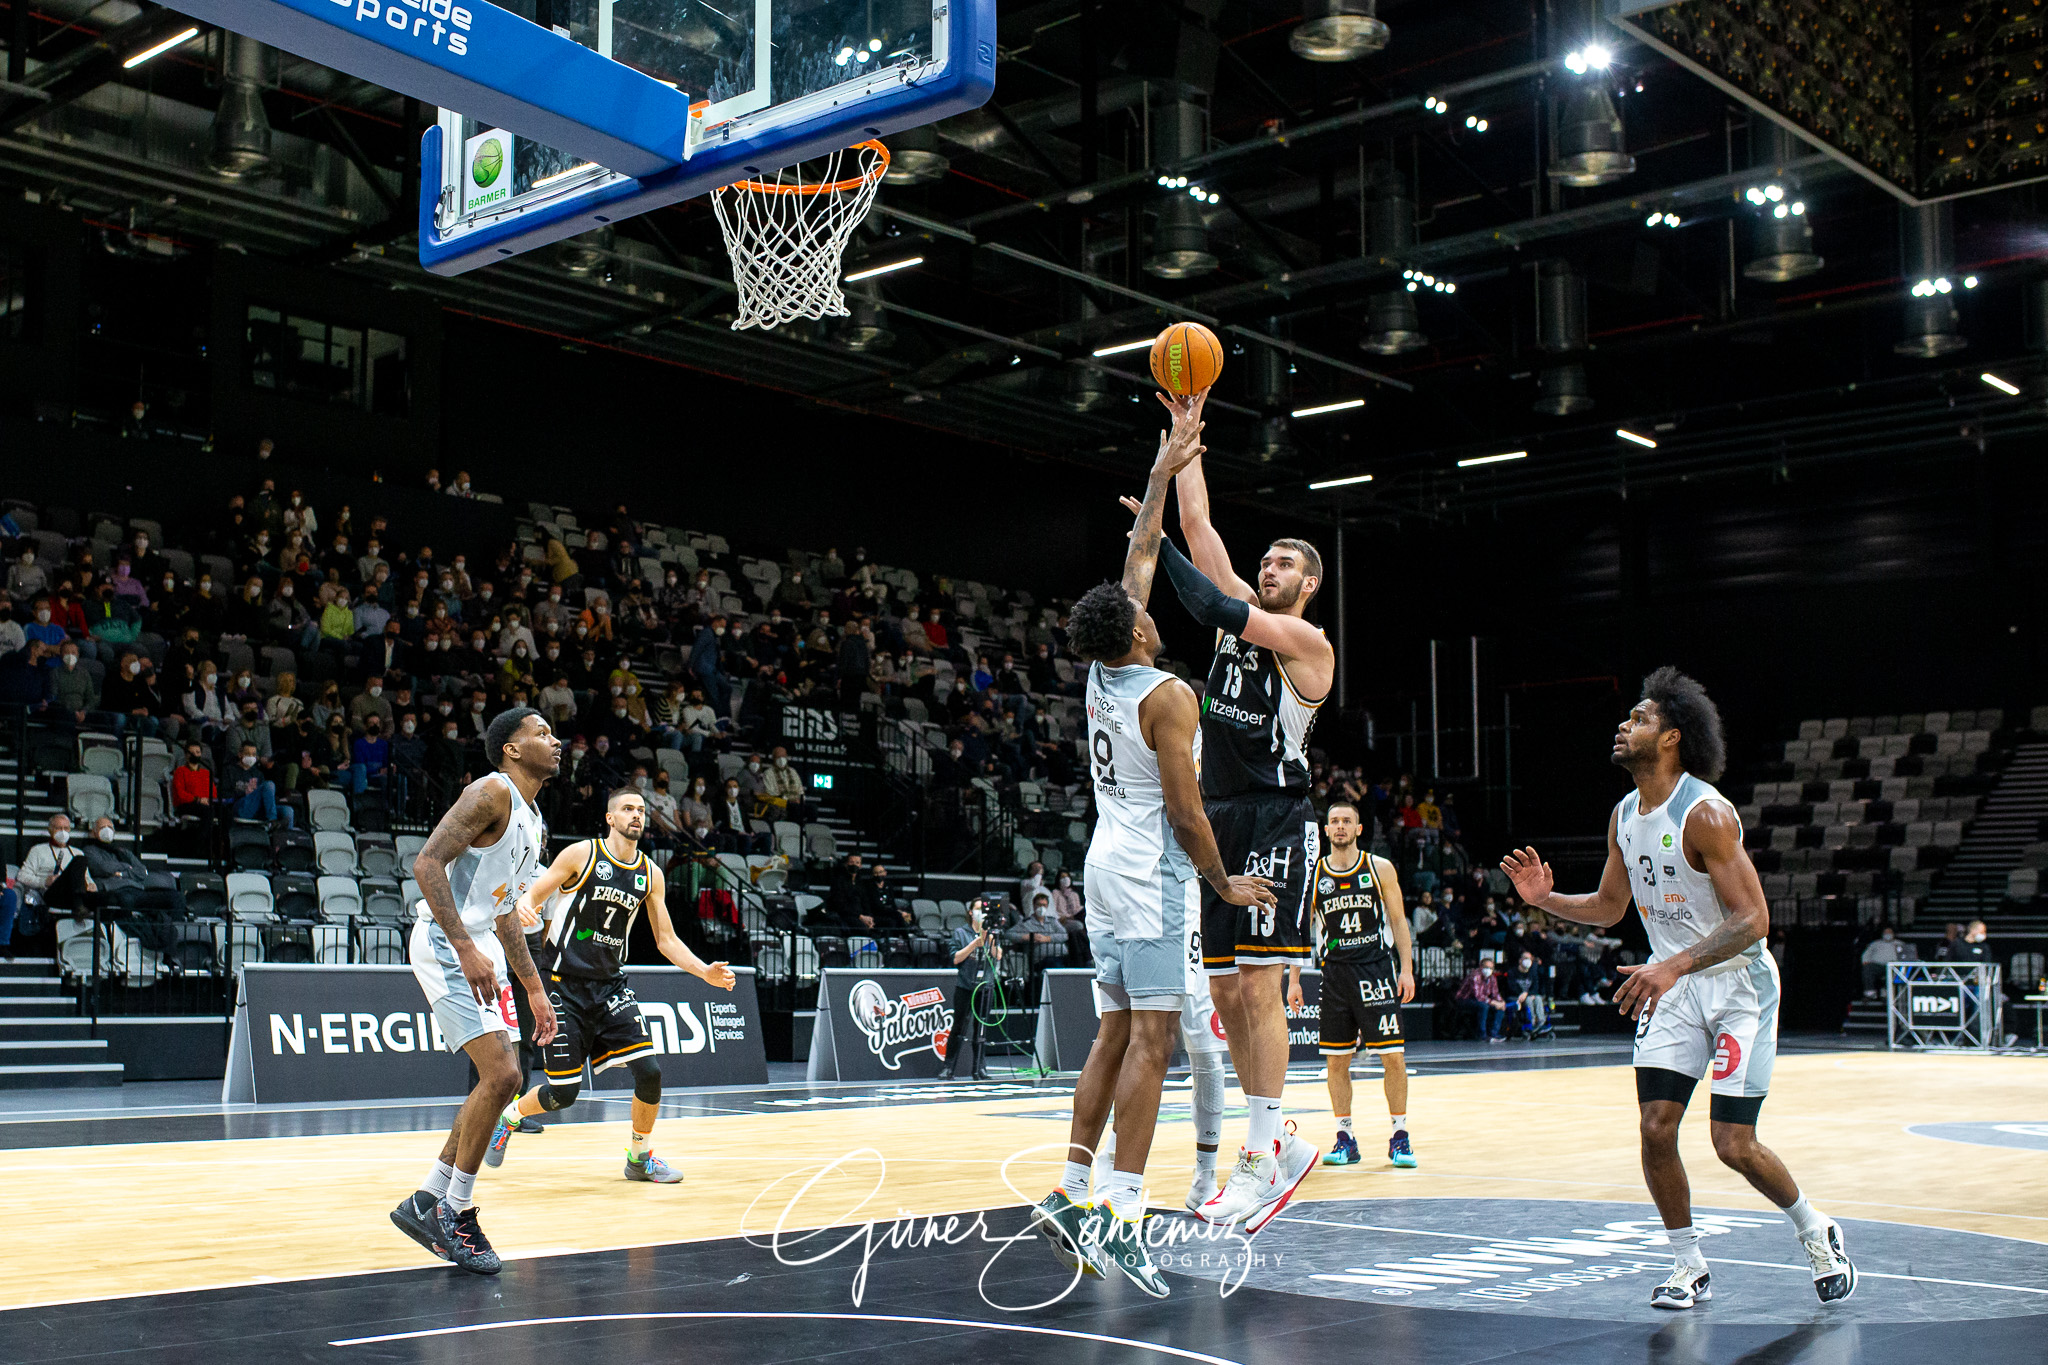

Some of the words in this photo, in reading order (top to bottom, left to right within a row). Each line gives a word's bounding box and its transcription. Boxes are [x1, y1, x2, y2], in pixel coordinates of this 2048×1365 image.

[468, 188, 506, 210] BARMER
[1169, 343, 1183, 391] Wilson
[1222, 662, 1243, 699] 13
[1209, 697, 1267, 726] Itzehoer
[1093, 728, 1118, 788] 9
[1638, 854, 1657, 888] 3
[591, 885, 641, 914] EAGLES
[1322, 894, 1374, 915] EAGLES
[1663, 893, 1686, 903] EMS
[603, 905, 618, 930] 7
[1247, 902, 1276, 938] 13
[1339, 911, 1362, 935] 44
[1338, 933, 1379, 948] Itzehoer
[1358, 977, 1395, 1002] B&H
[710, 1002, 737, 1015] Experts
[633, 1015, 649, 1036] 7
[712, 1015, 745, 1029] Managed
[713, 1028, 744, 1040] Services
[867, 1000, 955, 1054] Falcons
[1378, 1013, 1400, 1036] 44
[1457, 1259, 1675, 1303] Personal
